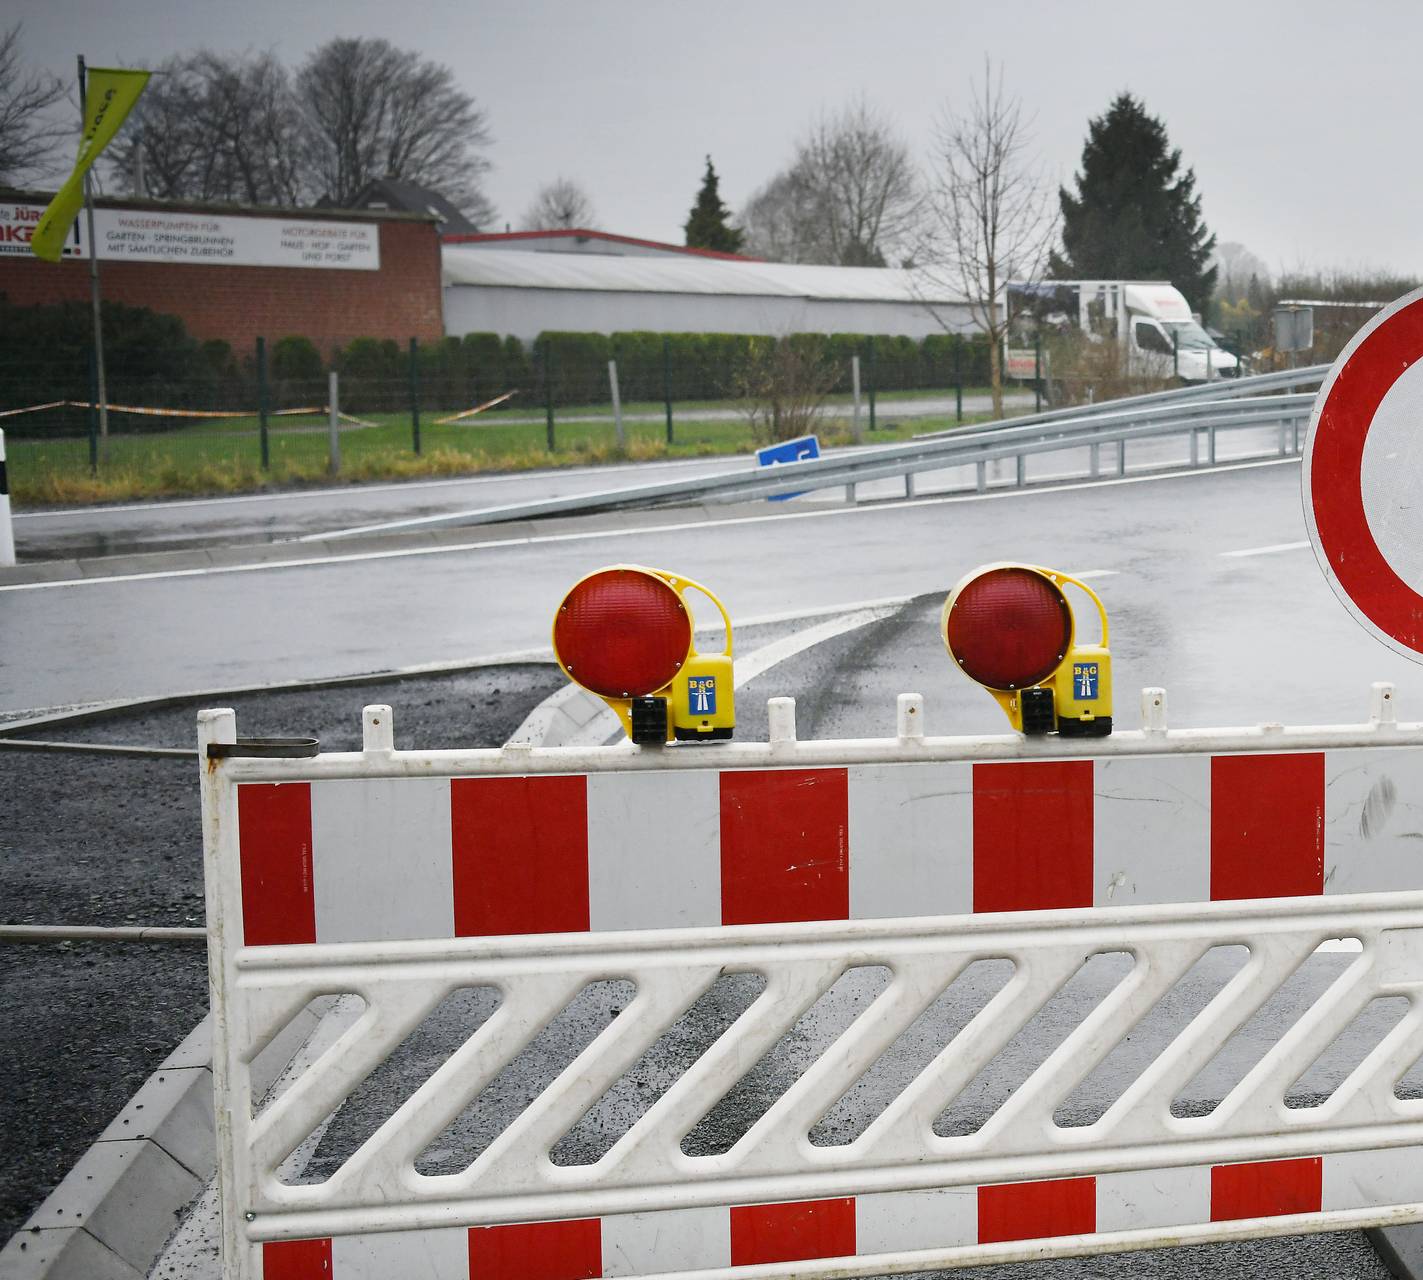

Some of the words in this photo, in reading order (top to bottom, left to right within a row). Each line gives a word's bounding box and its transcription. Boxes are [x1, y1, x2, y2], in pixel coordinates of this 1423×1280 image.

[118, 218, 199, 231] WASSERPUMPEN
[106, 230, 145, 242] GARTEN
[153, 232, 235, 246] SPRINGBRUNNEN
[107, 243, 125, 253] MIT
